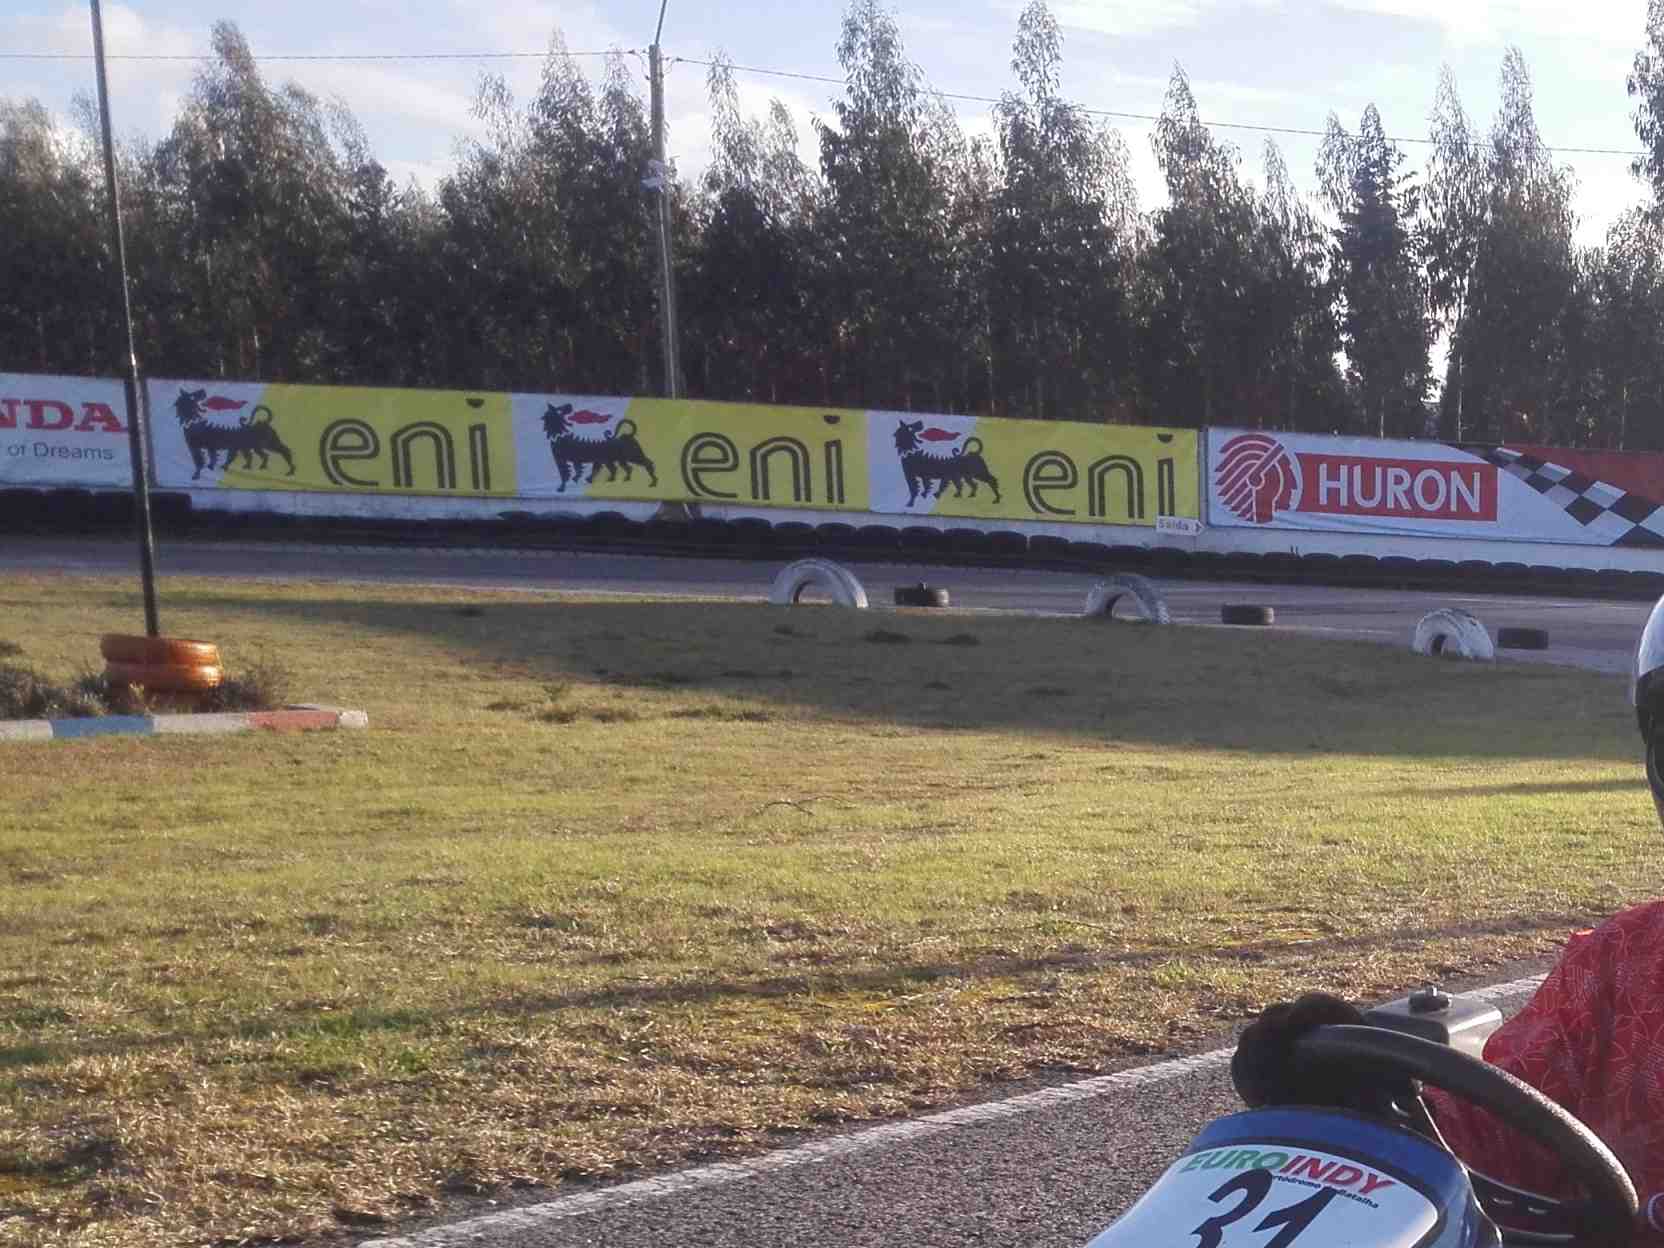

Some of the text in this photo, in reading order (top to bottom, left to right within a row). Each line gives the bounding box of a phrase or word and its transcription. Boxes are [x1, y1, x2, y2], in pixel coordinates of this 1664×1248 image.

[32, 442, 114, 461] Dreams
[319, 397, 492, 491] eni
[681, 414, 845, 504] eni
[1022, 433, 1176, 518] eni
[1319, 463, 1481, 513] HURON
[1180, 1149, 1395, 1196] EUROINDY
